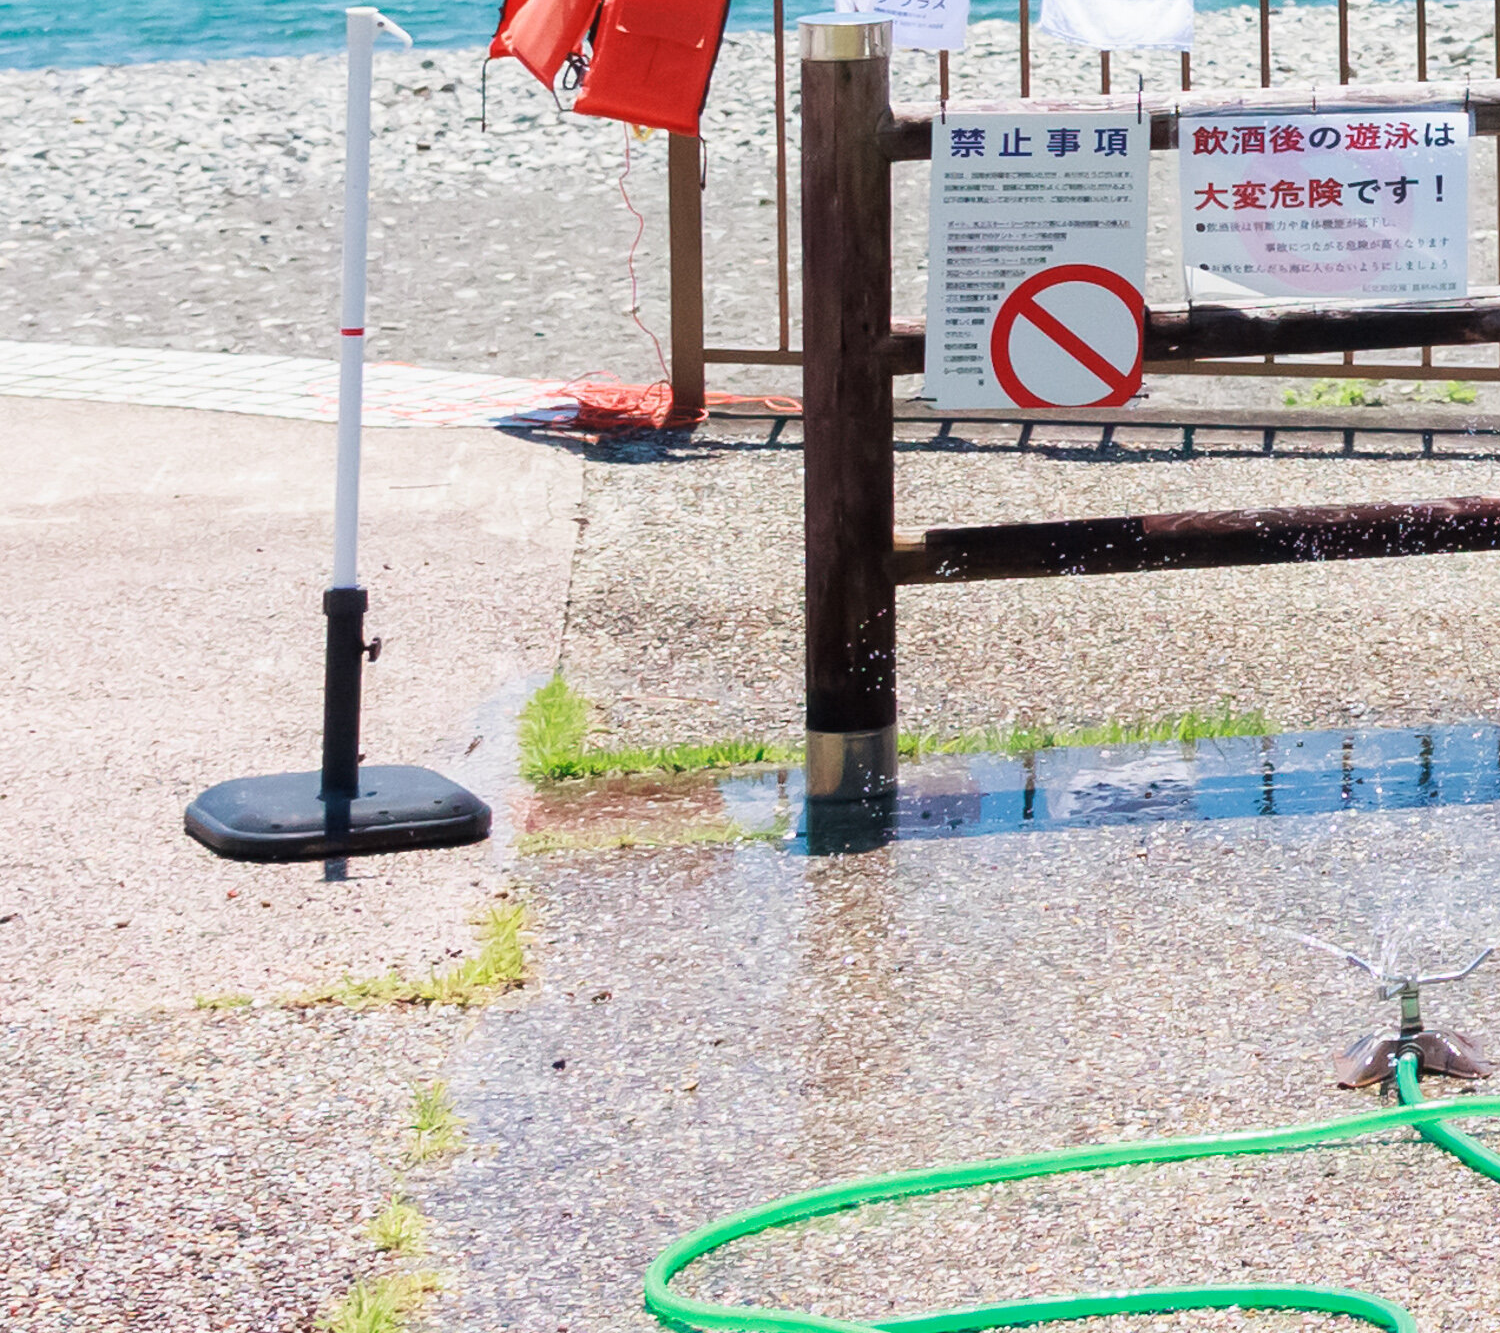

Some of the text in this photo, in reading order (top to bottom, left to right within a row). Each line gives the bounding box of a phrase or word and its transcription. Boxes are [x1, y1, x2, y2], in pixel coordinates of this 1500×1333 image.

[950, 127, 1130, 159] 禁止事項
[1192, 122, 1456, 156] 飲酒後の遊泳は
[1193, 174, 1444, 212] 大変危険です！
